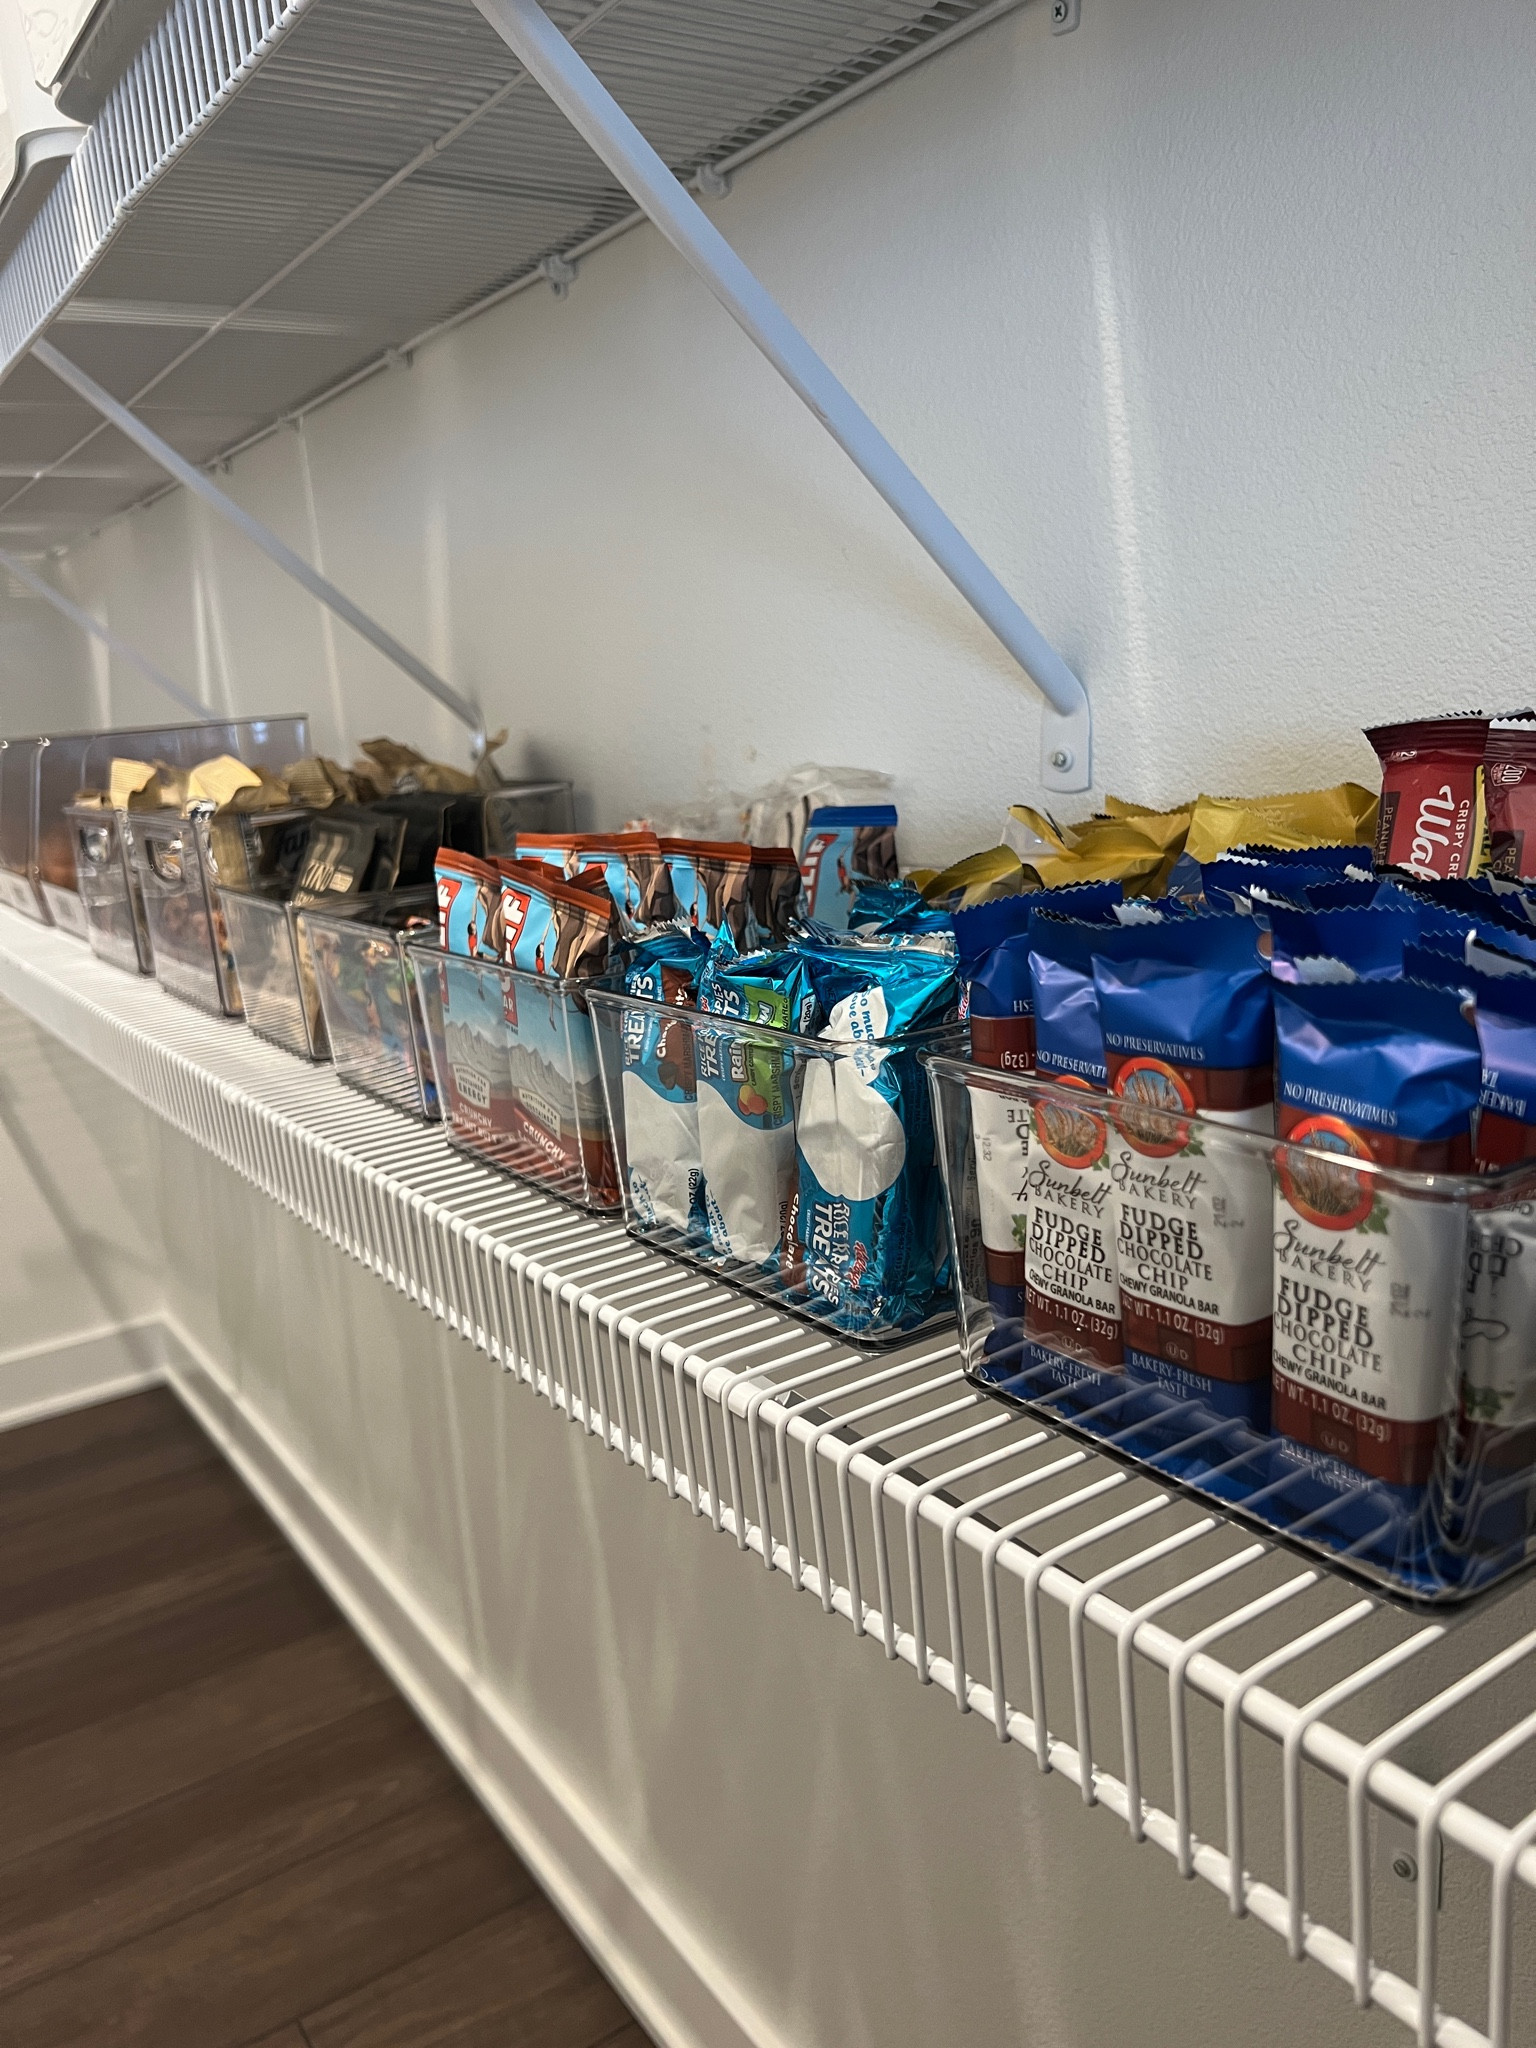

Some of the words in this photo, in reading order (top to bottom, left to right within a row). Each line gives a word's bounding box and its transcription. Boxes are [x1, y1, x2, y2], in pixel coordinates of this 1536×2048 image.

[1379, 806, 1394, 860] PEANUT
[1453, 800, 1470, 848] CRISPY
[705, 989, 740, 1077] TRETS
[1105, 1032, 1121, 1046] NO
[1124, 1036, 1206, 1061] PRESERVATIVES
[699, 1044, 708, 1078] RICE
[1000, 1051, 1029, 1069] (32g)
[1036, 1050, 1050, 1063] NO
[1284, 1081, 1303, 1100] NO
[1304, 1087, 1398, 1127] PRESERVATIVES
[523, 1121, 566, 1161] CRUNCHY
[688, 1168, 700, 1190] (22g)
[1028, 1160, 1112, 1204] Sunbelt
[1111, 1151, 1207, 1194] Sunbelt
[1119, 1178, 1198, 1210] BAKERY
[1035, 1185, 1106, 1219] BAKERY
[1120, 1203, 1198, 1241] FUDGE
[1031, 1221, 1106, 1264] DIPPED
[1034, 1206, 1102, 1247] FUDGE
[1119, 1220, 1204, 1260] DIPPED
[1273, 1219, 1386, 1276] Sunbelt
[1029, 1237, 1113, 1284] CHOCOLATE
[1041, 1263, 1089, 1292] CHIP
[1116, 1237, 1213, 1281] CHOCOLATE
[1137, 1263, 1189, 1291] CHIP
[1279, 1249, 1372, 1293] BAKERY
[1029, 1268, 1050, 1291] CHEWY
[1050, 1283, 1094, 1309] GRANOLA
[1095, 1298, 1116, 1315] BAR
[1120, 1272, 1147, 1293] CHEWY
[1150, 1284, 1195, 1309] GRANOLA
[1197, 1299, 1219, 1316] BAR
[1279, 1276, 1369, 1328] FUDGE
[1036, 1294, 1053, 1316] WT.
[1054, 1304, 1069, 1321] 1.1
[1071, 1309, 1088, 1329] OZ.
[1090, 1317, 1119, 1341] (32g)
[1135, 1302, 1155, 1320] WT.
[1156, 1308, 1171, 1325] 1.1
[1173, 1315, 1193, 1334] OZ.
[1195, 1322, 1224, 1345] (32g)
[1277, 1293, 1374, 1349] DIPPED
[1273, 1312, 1382, 1373] CHOCOLATE
[1292, 1343, 1353, 1380] CHIP
[1030, 1345, 1101, 1387] BAKERY-FRESH
[1050, 1367, 1079, 1390] TASTE
[1132, 1351, 1213, 1393] BAKERY-FRESH
[1156, 1376, 1188, 1398] TASTE
[1273, 1349, 1302, 1376] CHEWY
[1304, 1367, 1358, 1401] GRANOLA
[1360, 1389, 1387, 1411] BAR
[1287, 1384, 1309, 1407] WT.
[1311, 1393, 1328, 1414] 1.1
[1331, 1403, 1353, 1427] OZ.
[1356, 1409, 1392, 1443] (32g)
